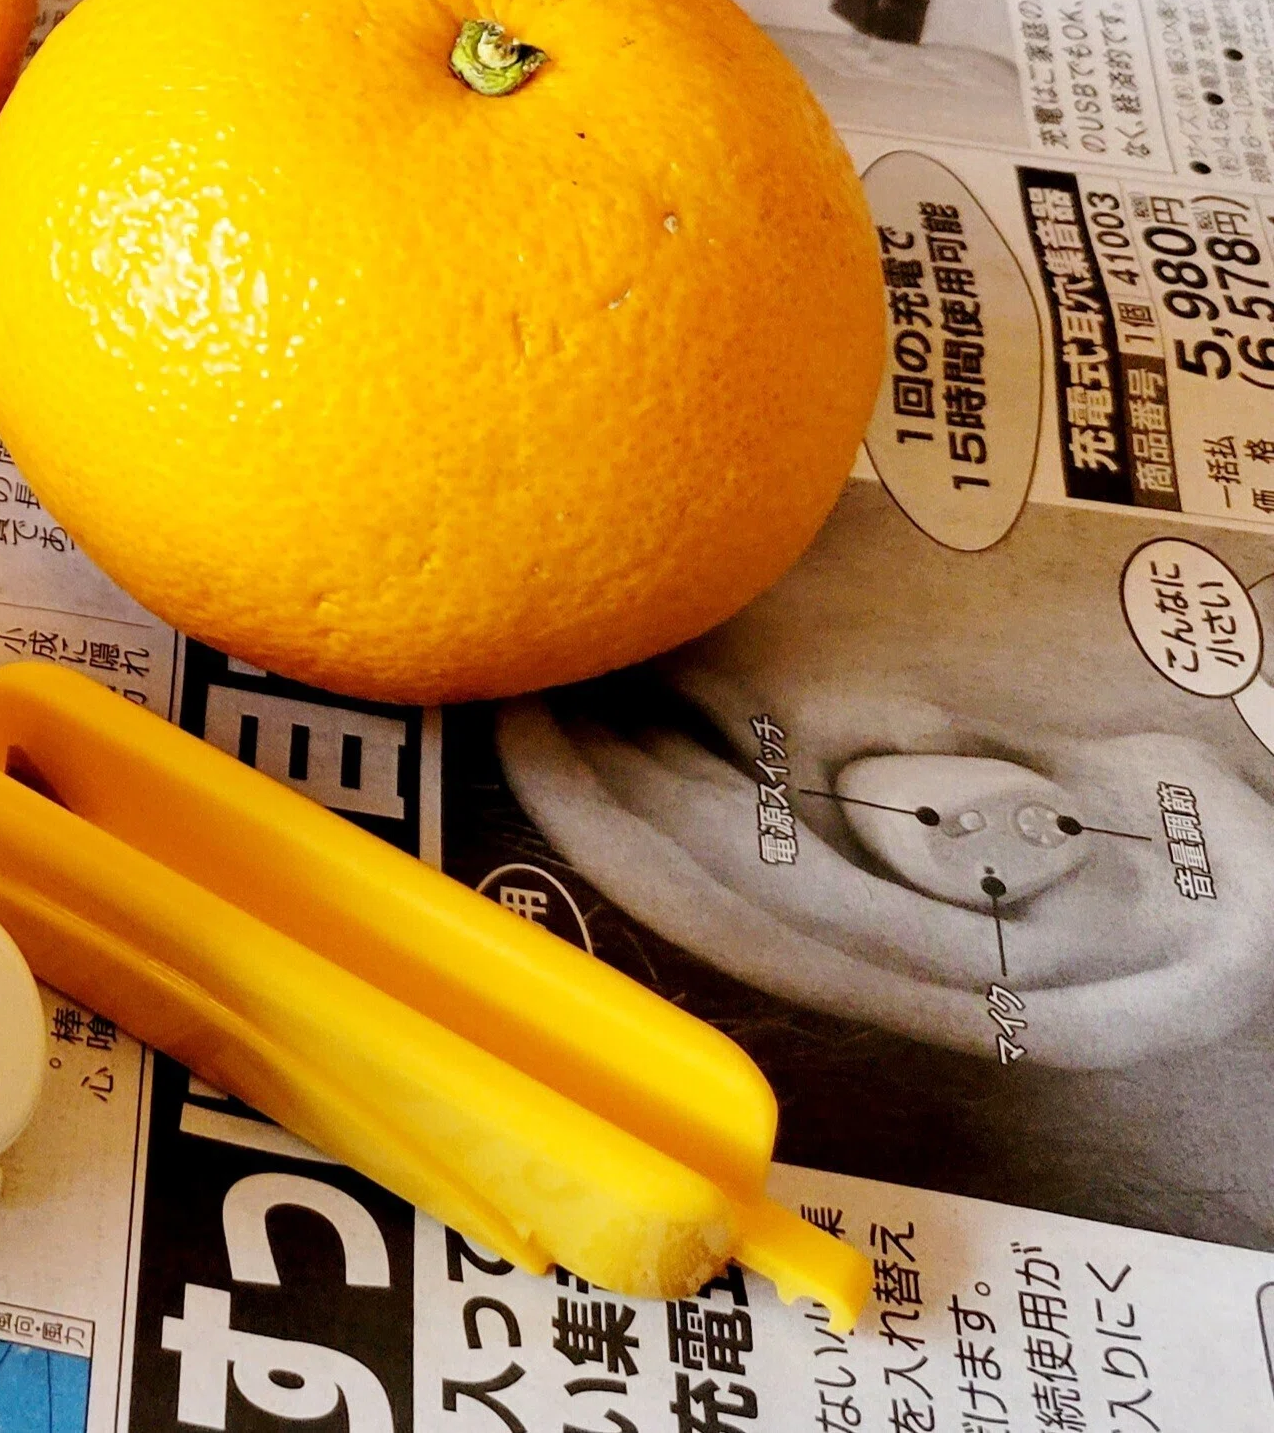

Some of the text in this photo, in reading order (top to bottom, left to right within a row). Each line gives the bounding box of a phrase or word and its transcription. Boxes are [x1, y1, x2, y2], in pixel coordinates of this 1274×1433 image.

[1086, 190, 1142, 286] 41003
[877, 223, 935, 446] 1回の充電で
[918, 200, 992, 492] 15時間使用可能
[1028, 186, 1120, 474] 充電式耳穴集音器
[1117, 300, 1157, 347] 1個
[1122, 368, 1177, 494] 商品番号
[1203, 434, 1241, 509] 一括払
[1149, 559, 1201, 675] こんなに
[1200, 580, 1246, 669] 小さい
[751, 713, 799, 867] 電源スイッチ
[1158, 781, 1217, 901] 音量調節
[992, 983, 1027, 1066] マイク
[552, 1263, 640, 1433] い集
[949, 1281, 1009, 1433] けます。
